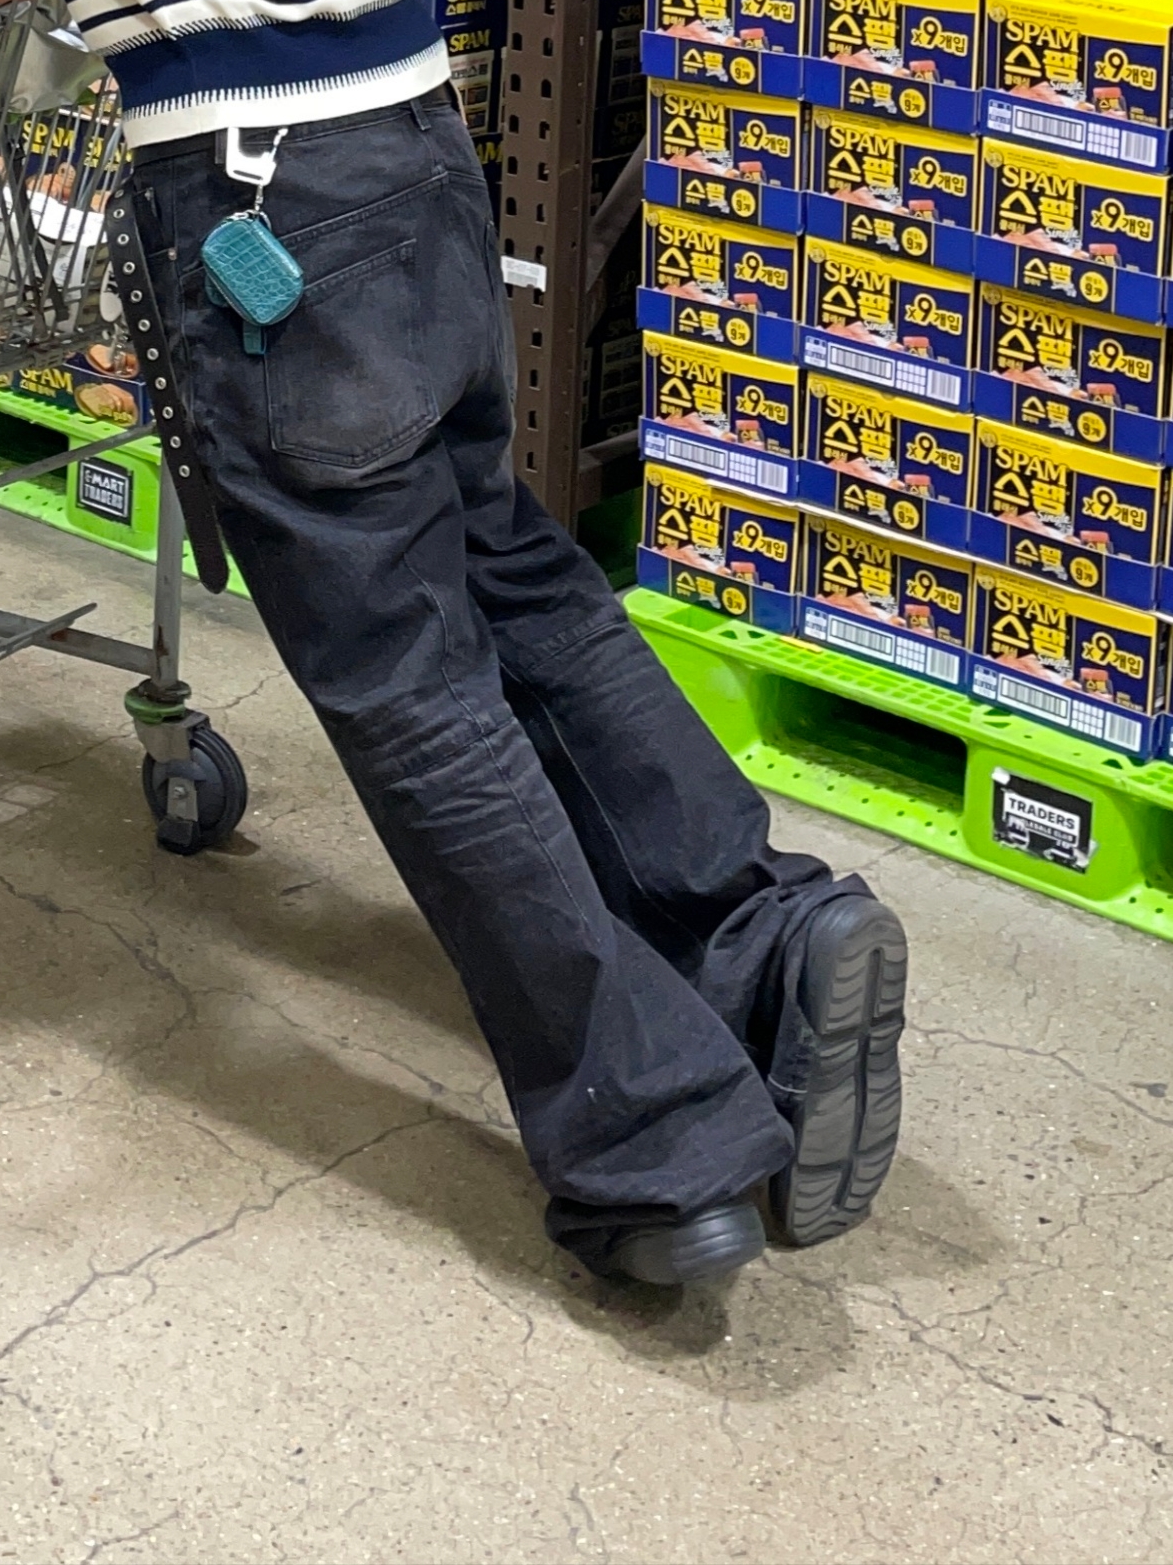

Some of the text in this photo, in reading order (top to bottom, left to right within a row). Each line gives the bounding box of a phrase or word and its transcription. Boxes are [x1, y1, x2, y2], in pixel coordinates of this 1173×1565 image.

[449, 29, 491, 53] SPAM
[828, 13, 897, 50] 스팸
[1005, 19, 1080, 53] SPAM
[682, 48, 724, 69] 스팸
[1004, 43, 1079, 82] 스팸
[664, 94, 726, 123] SPAM
[23, 120, 76, 149] SPAM
[663, 116, 726, 151] 스팸
[829, 125, 896, 159] SPAM
[828, 150, 895, 188] 스팸
[1002, 164, 1076, 201] SPAM
[851, 214, 895, 239] 스팸
[999, 190, 1074, 231] 스팸
[999, 301, 1074, 341] SPAM
[997, 328, 1074, 370] 스팸
[825, 395, 892, 432] SPAM
[823, 420, 893, 460] 스팸
[825, 530, 892, 568] SPAM
[823, 555, 892, 597] 스팸
[993, 589, 1067, 631] SPAM
[992, 615, 1067, 660] 스팸
[1008, 795, 1075, 830] TRADERS
